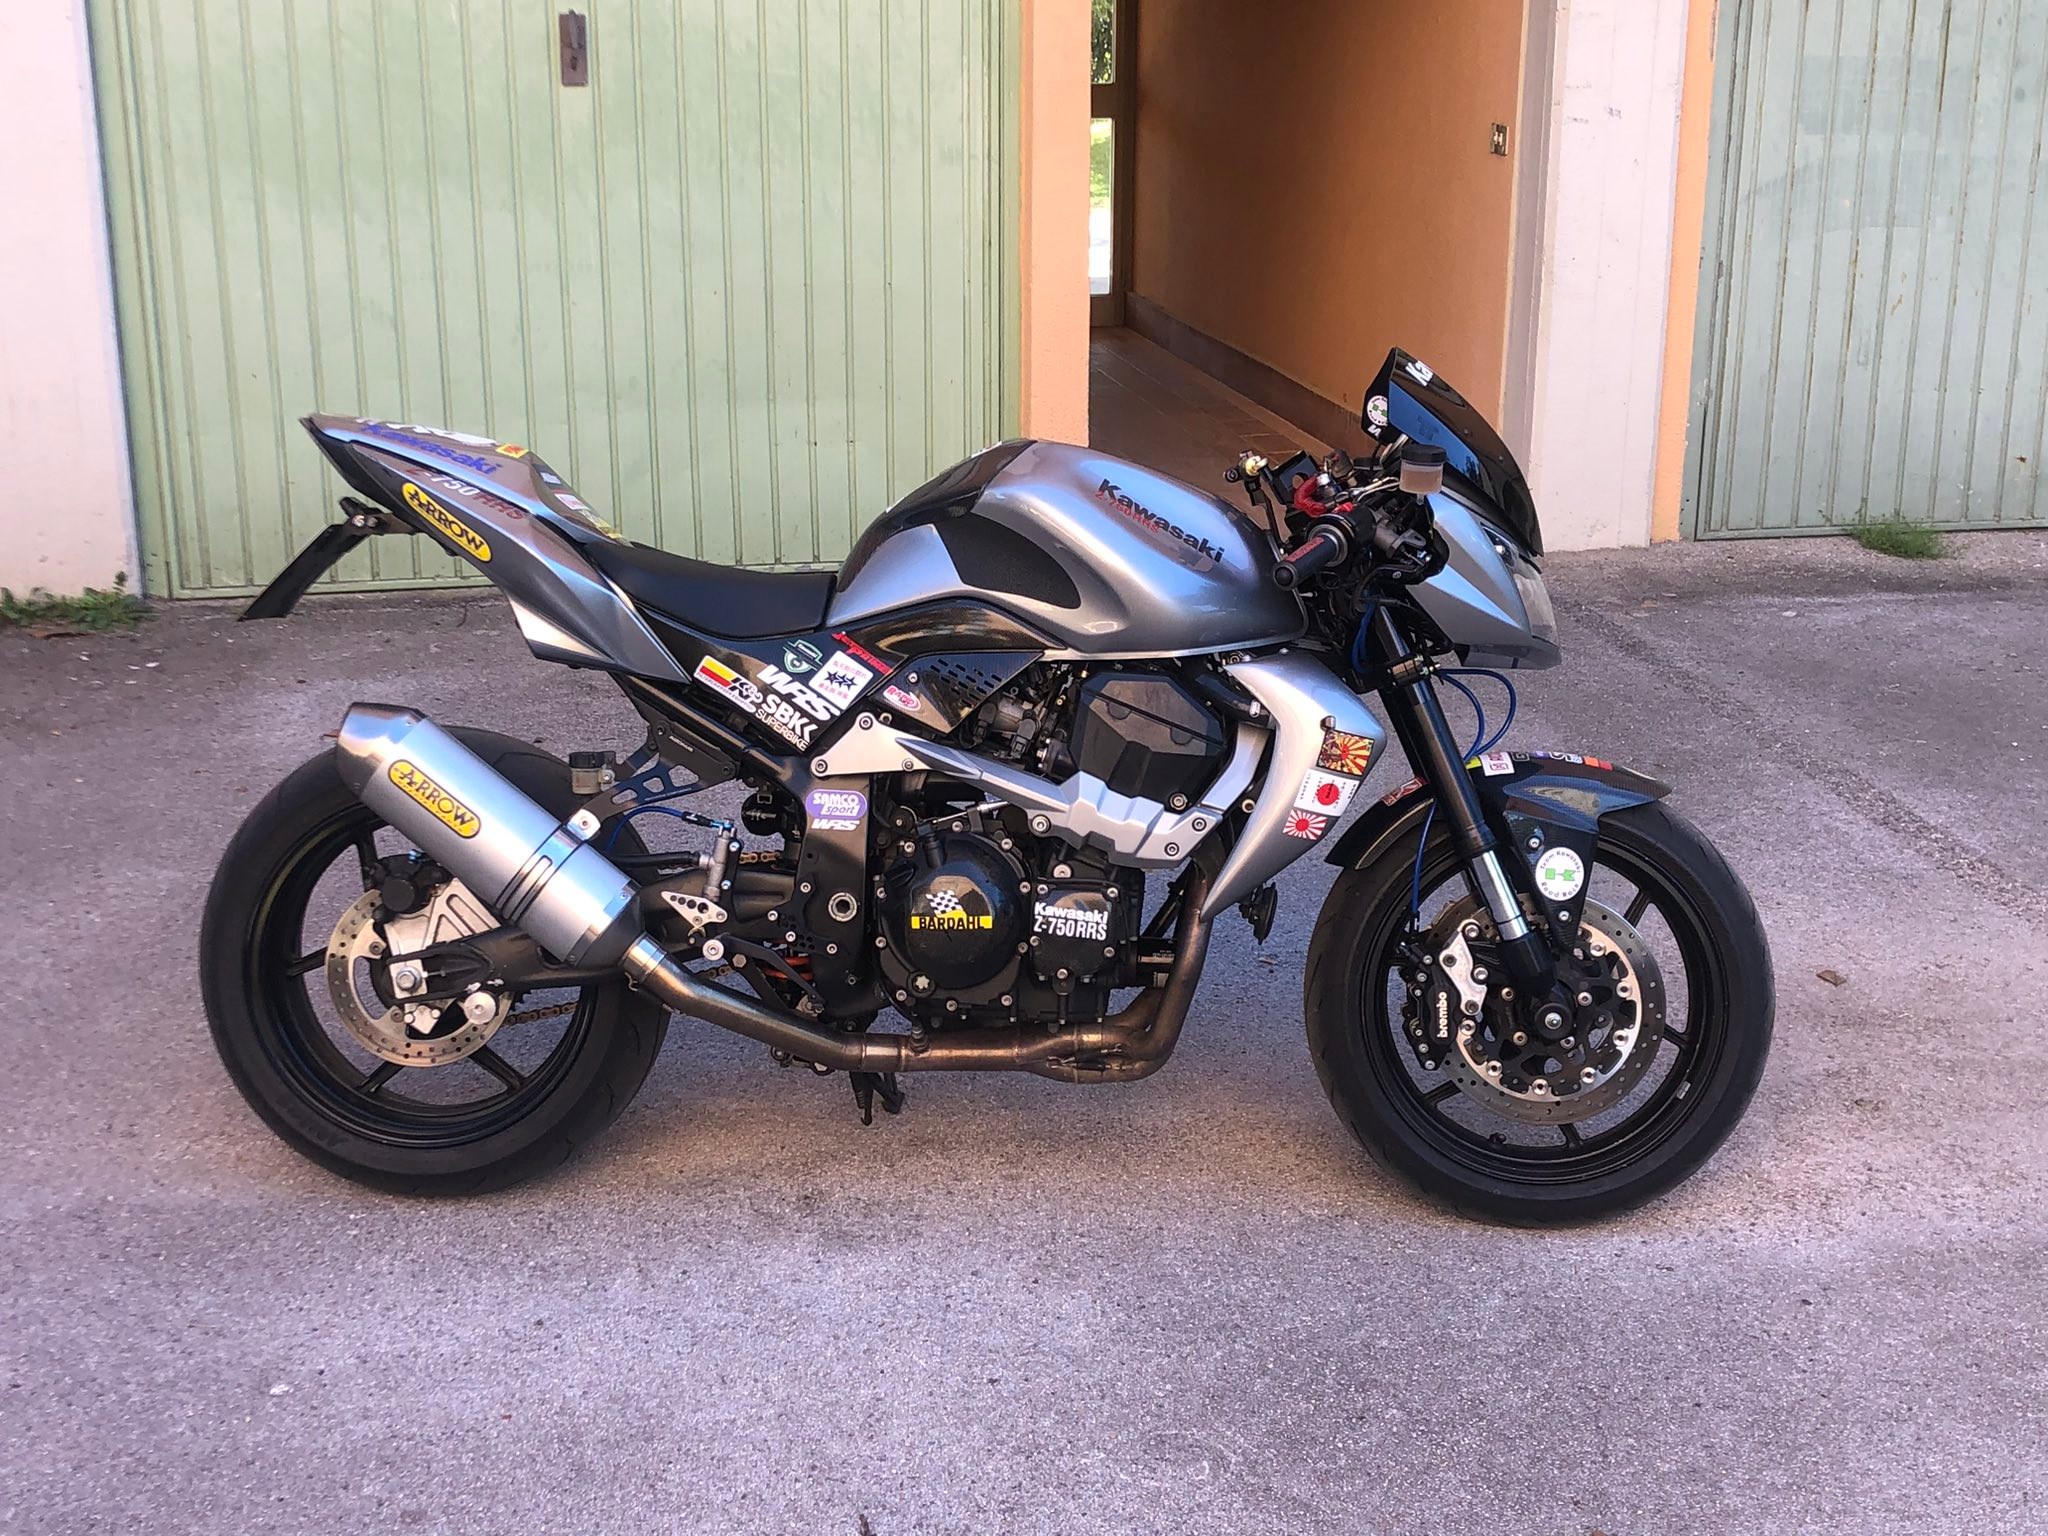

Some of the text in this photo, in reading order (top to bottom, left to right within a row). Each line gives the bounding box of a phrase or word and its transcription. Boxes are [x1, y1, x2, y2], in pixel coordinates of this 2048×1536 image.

[408, 489, 484, 550] ARROW
[1098, 478, 1225, 562] Kawasaki
[756, 664, 841, 721] WRS
[755, 708, 809, 751] SUPERBIKE
[761, 694, 819, 743] SBK
[399, 769, 475, 826] ARROW
[813, 792, 859, 806] SAMCO
[826, 805, 856, 816] sport
[811, 818, 860, 831] WRS
[919, 917, 985, 930] BARDAHL
[1033, 915, 1107, 941] Z-750RRS
[1034, 901, 1109, 924] Kawasaki
[1436, 991, 1448, 1038] brembo
